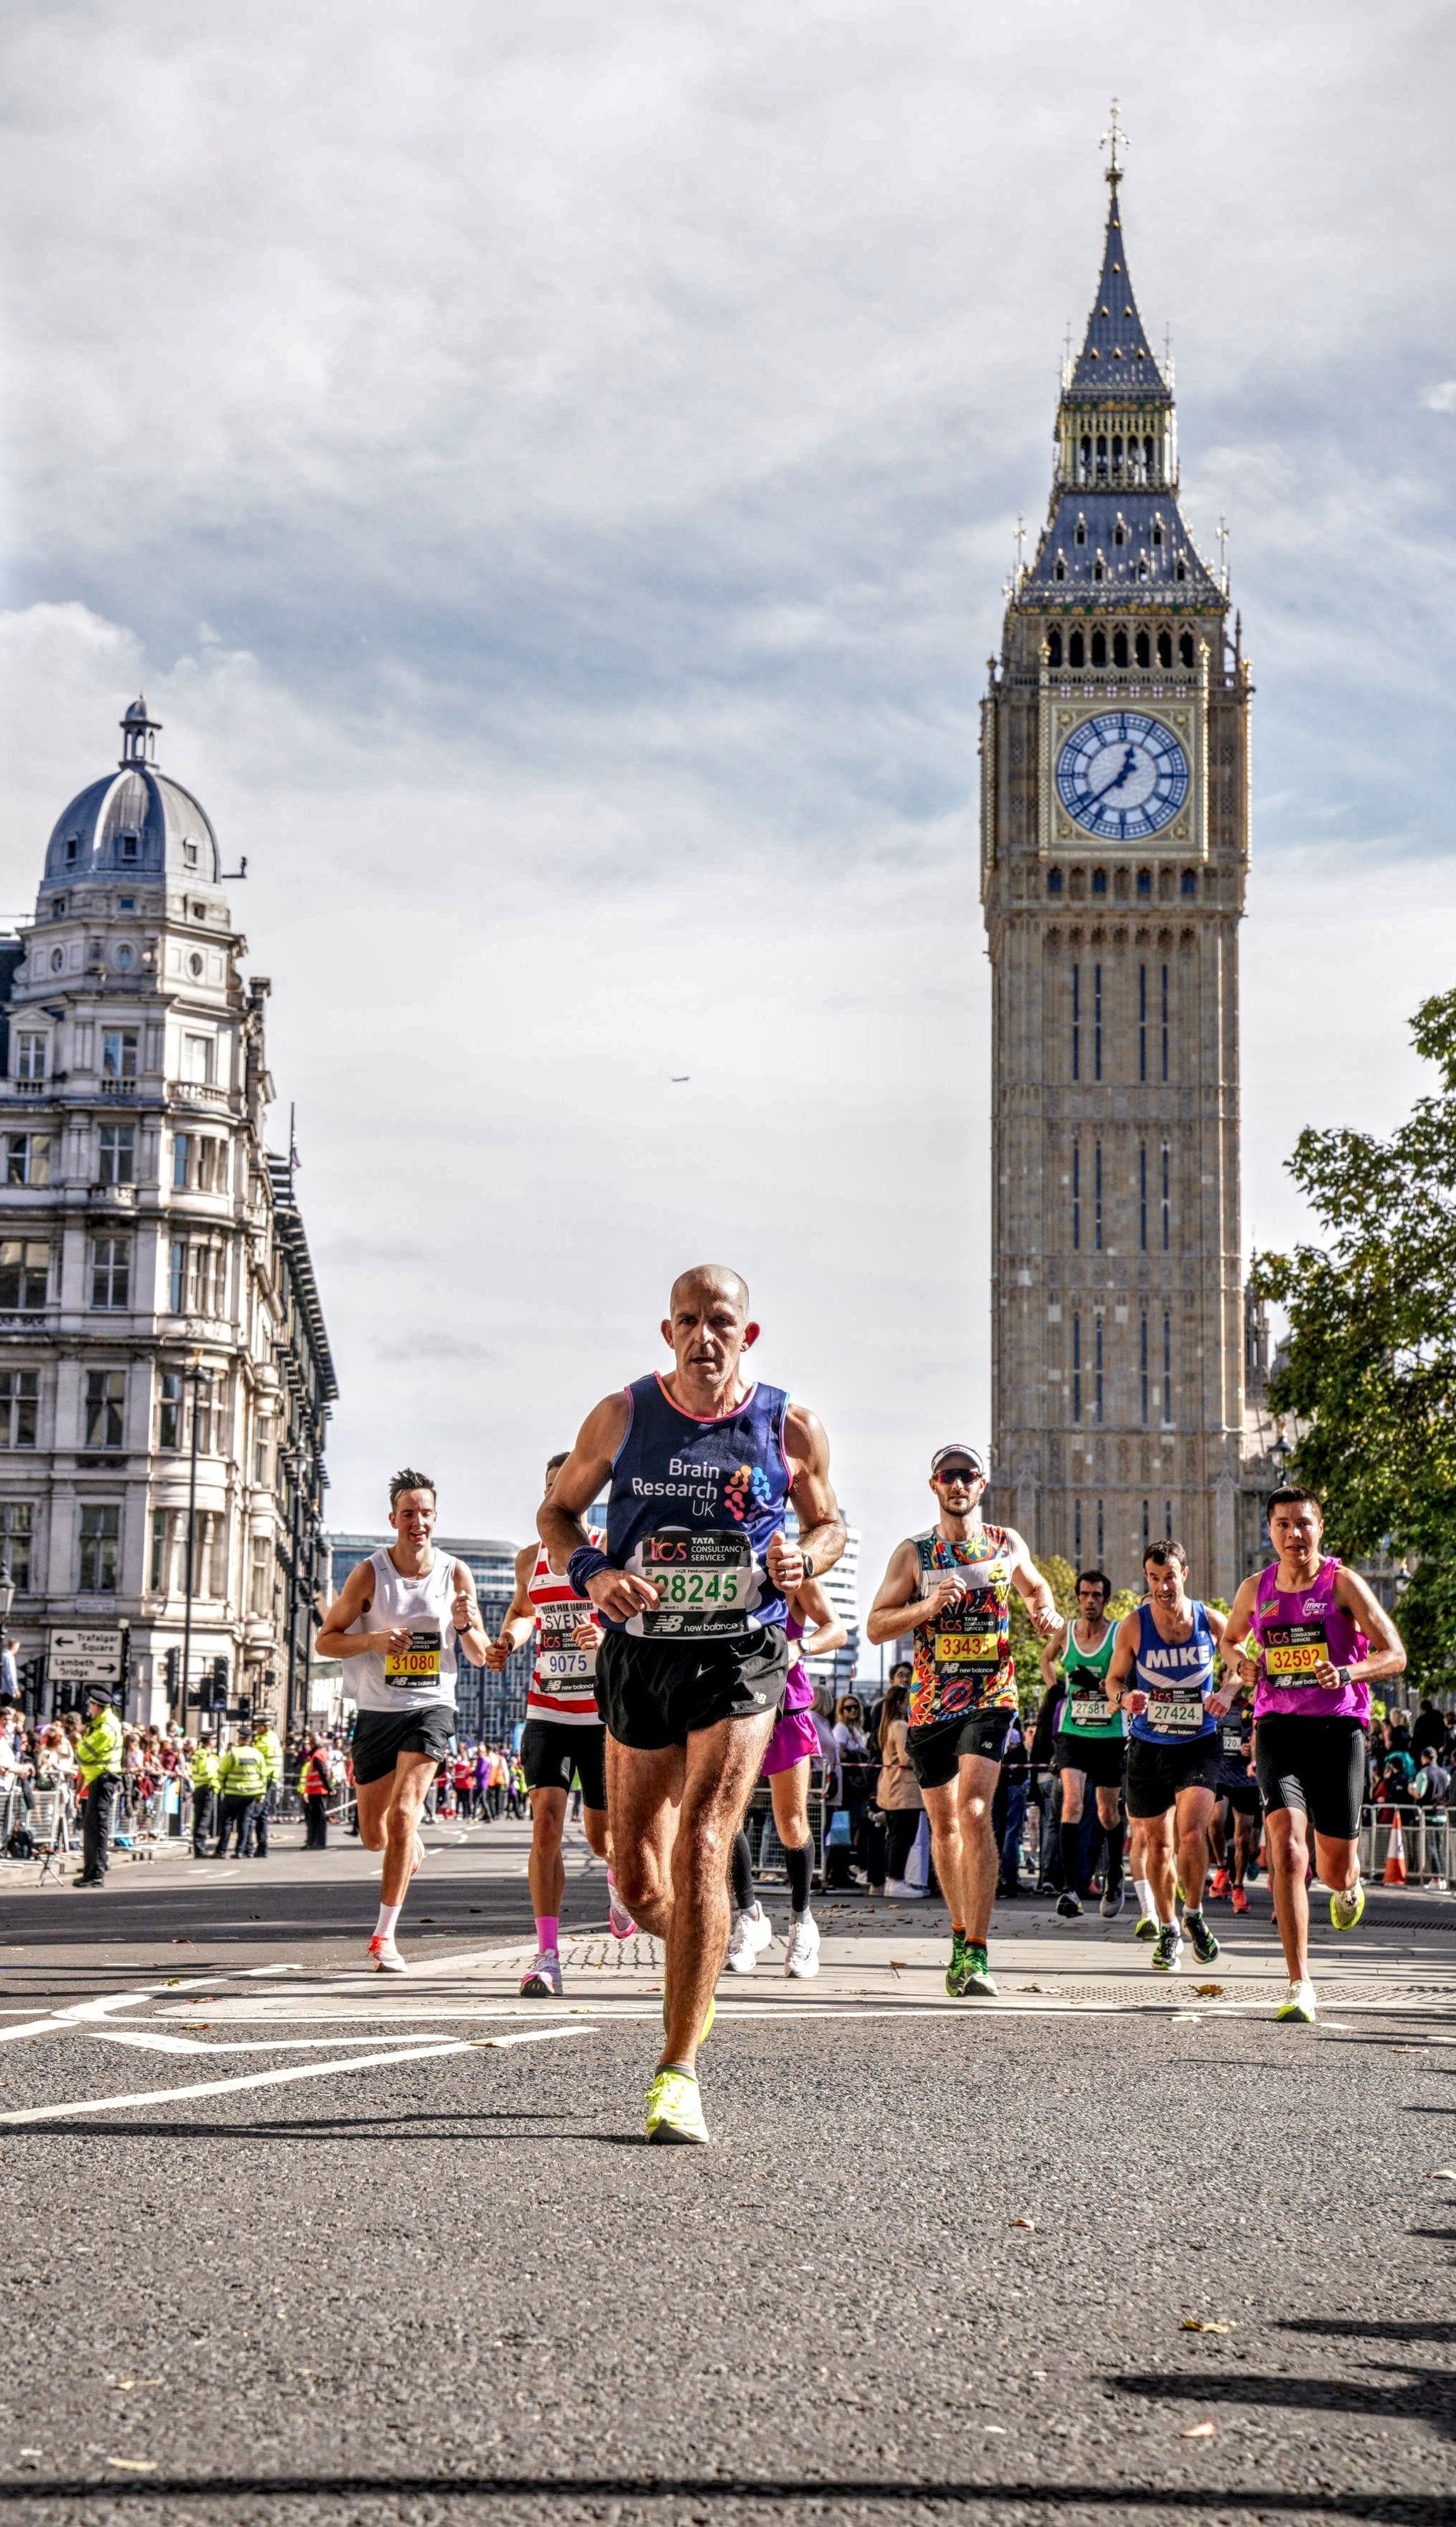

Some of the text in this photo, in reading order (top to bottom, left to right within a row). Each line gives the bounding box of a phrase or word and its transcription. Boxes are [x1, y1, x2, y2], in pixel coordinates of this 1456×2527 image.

[669, 1458, 720, 1480] Brain
[632, 1477, 718, 1500] Research
[692, 1500, 716, 1517] UK
[651, 1537, 687, 1561] tcs
[654, 1574, 738, 1603] 28245
[556, 1603, 570, 1612] PARK
[545, 1613, 582, 1629] SVEN
[703, 1623, 738, 1631] balance
[941, 1618, 962, 1631] tcs
[78, 1633, 118, 1643] Trafalgar
[543, 1634, 560, 1648] tcs
[1267, 1631, 1289, 1644] tcs
[81, 1643, 114, 1652] Square
[943, 1637, 990, 1655] 33435
[392, 1655, 434, 1670] 31080
[550, 1654, 587, 1673] 9075
[1146, 1645, 1210, 1669] MIKE
[1273, 1648, 1320, 1669] 32592
[1076, 1702, 1105, 1714] 27581
[1154, 1706, 1195, 1720] 27424
